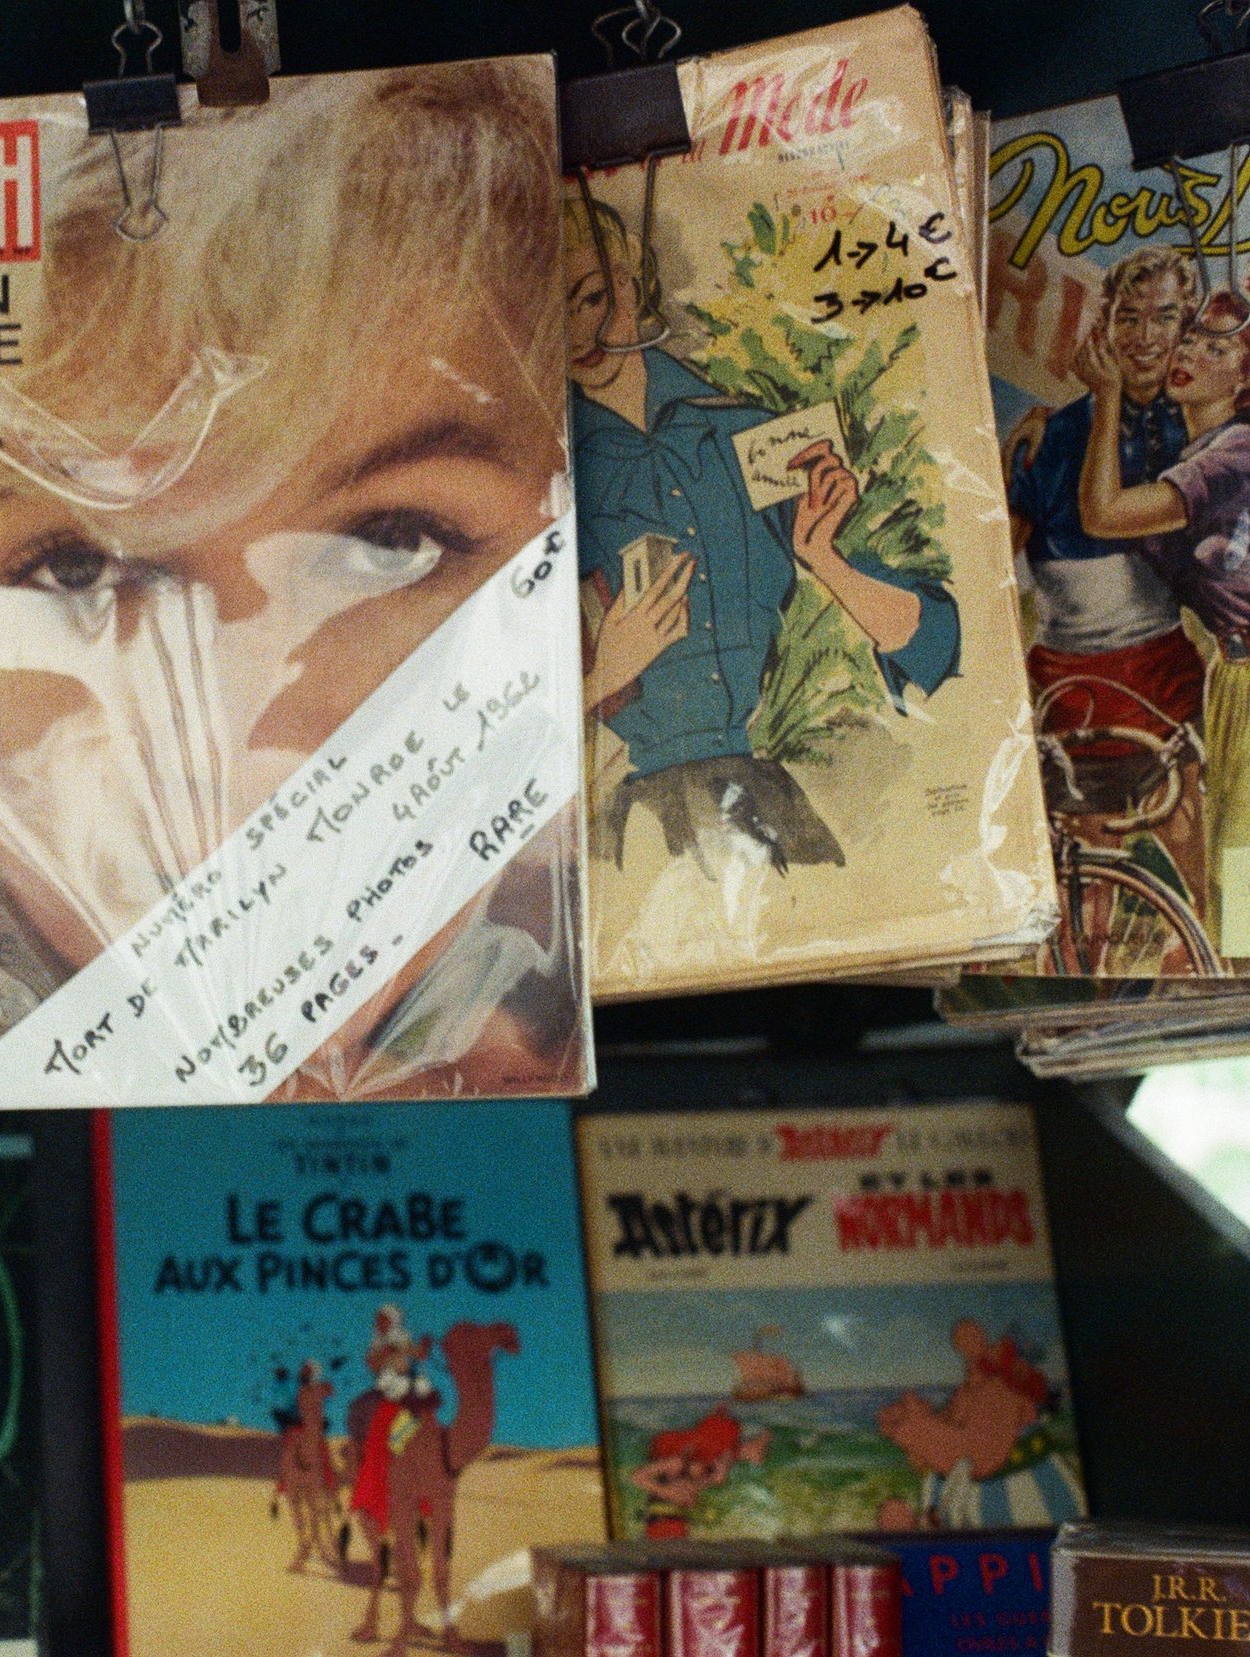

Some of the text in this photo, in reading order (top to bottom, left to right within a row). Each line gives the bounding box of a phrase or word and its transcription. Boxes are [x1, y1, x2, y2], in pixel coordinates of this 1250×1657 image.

[469, 776, 549, 862] RARE
[237, 1031, 289, 1087] 36
[300, 945, 379, 1024] PAGES
[44, 1012, 114, 1075] MORT
[225, 1191, 467, 1244] LE CRABE
[154, 1240, 550, 1294] AUX PINCES D'OR
[1152, 1573, 1228, 1602] J.R.R.
[1092, 1600, 1250, 1641] TOLKIE
